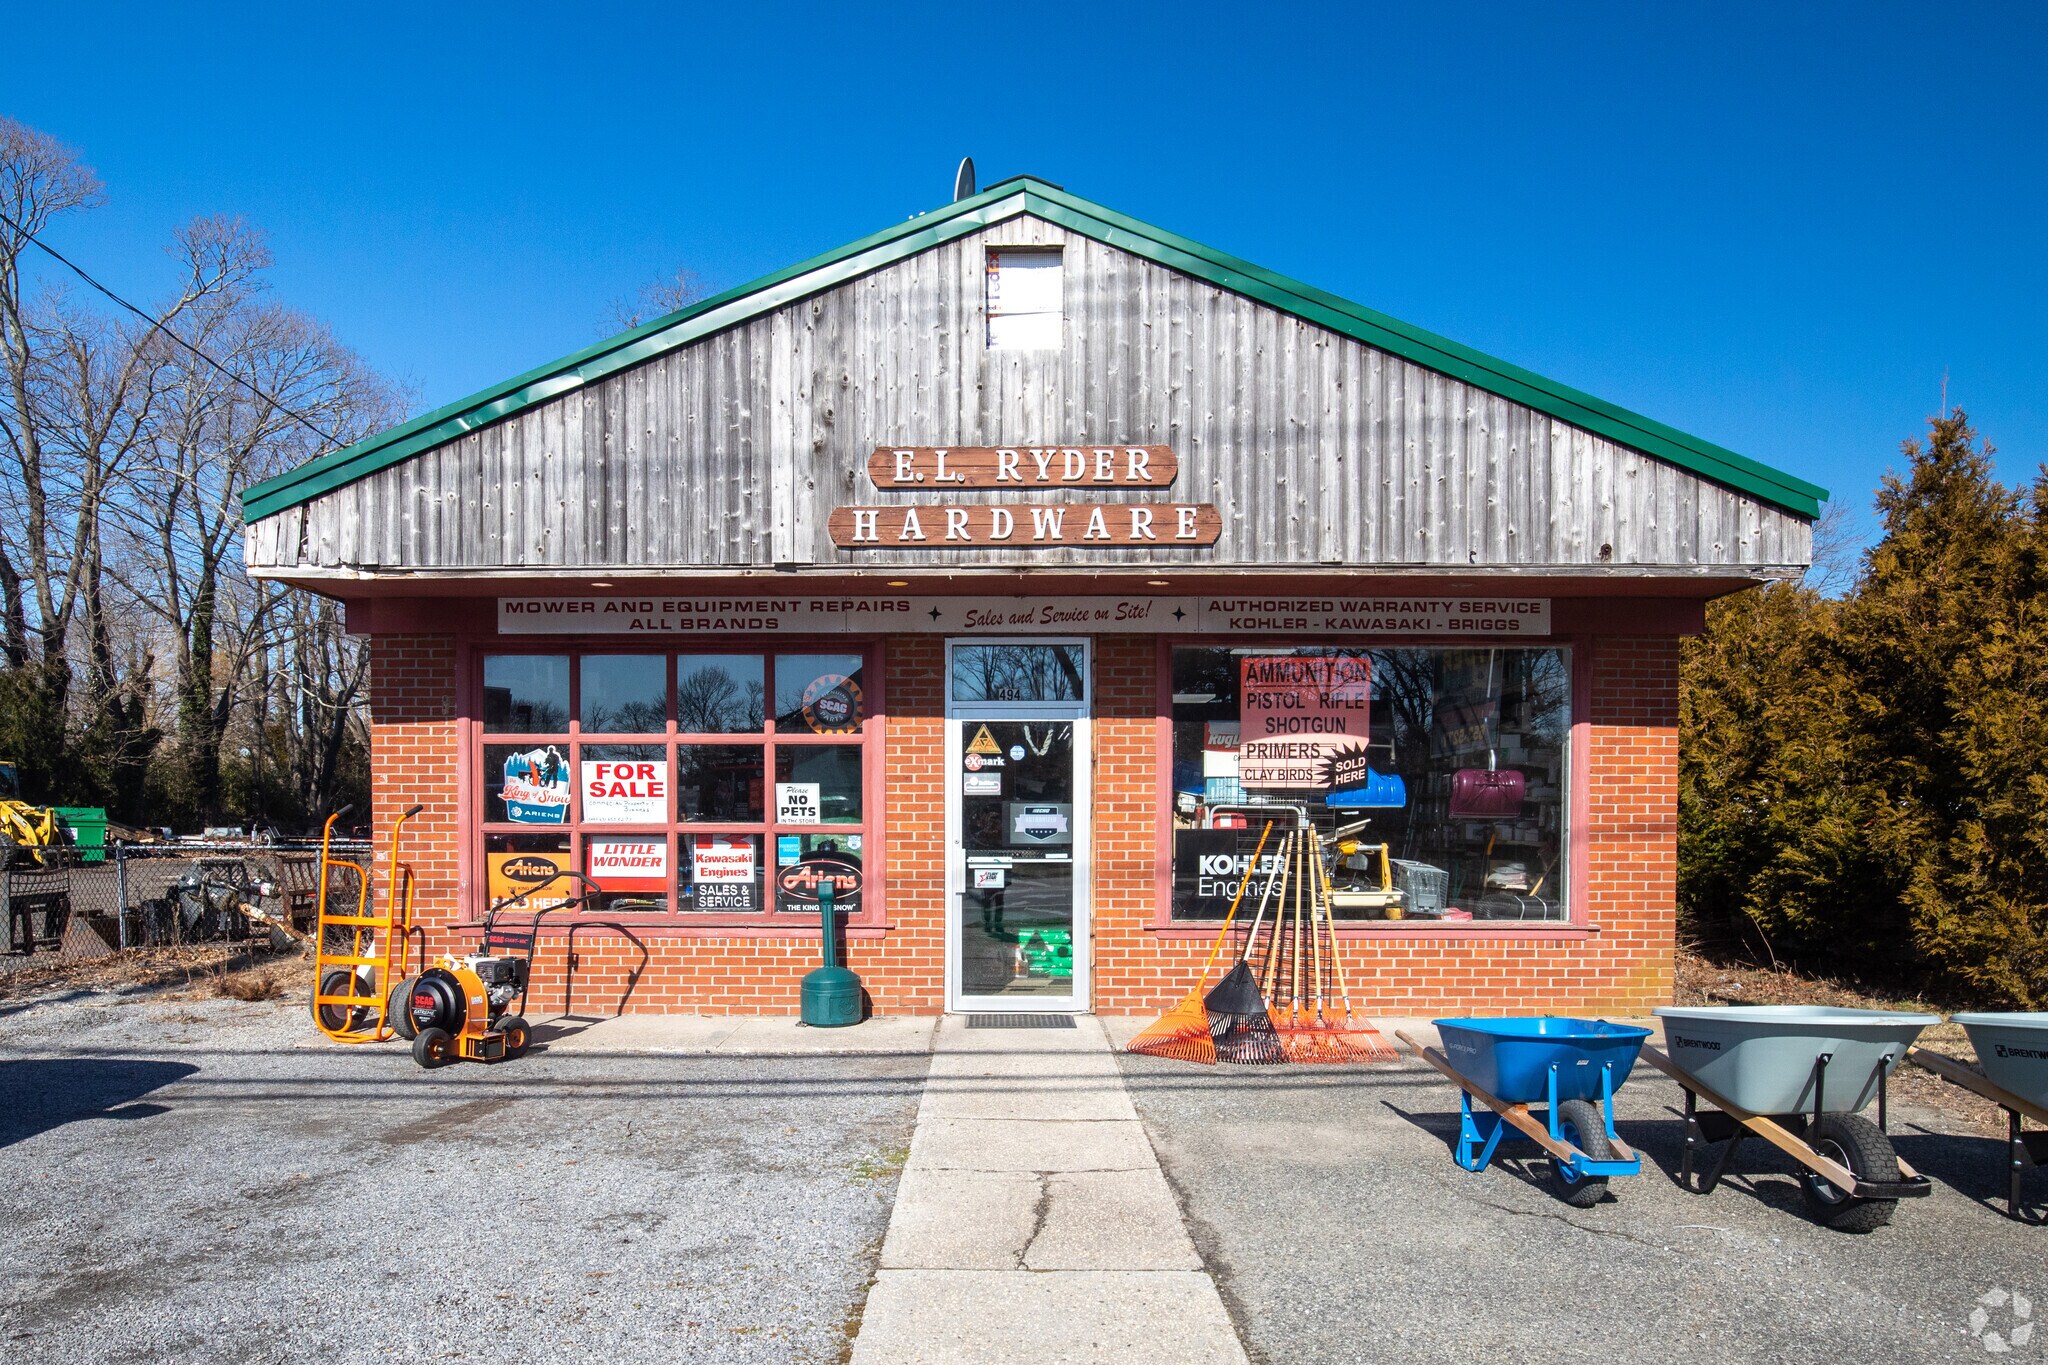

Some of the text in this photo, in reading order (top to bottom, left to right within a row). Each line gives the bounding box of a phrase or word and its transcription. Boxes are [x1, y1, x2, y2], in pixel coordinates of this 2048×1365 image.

[893, 448, 1152, 482] E.L. RYDER
[852, 506, 1198, 542] HARDWARE
[505, 600, 910, 614] MOWER AND EQUIPMENT REPAIRS
[964, 600, 1153, 628] Sales and Service on Site!
[1208, 600, 1541, 615] AUTHORIZED WARRANTY SERVICE
[629, 617, 779, 630] ALL BRANDS
[1229, 617, 1308, 630] KOHLER
[1325, 618, 1432, 631] KAWASAKI
[1449, 618, 1520, 631] BRIGGS
[1246, 661, 1367, 683] AMMUNITION
[999, 689, 1021, 700] 494
[1246, 692, 1364, 710] PISTOL RIFLE
[819, 699, 848, 714] SCAG
[820, 711, 844, 722] PARTS
[1265, 716, 1347, 734] SHOTGUN
[1246, 742, 1321, 759] PRIMERS
[964, 756, 1005, 768] eXmark
[1335, 756, 1366, 773] SOLD
[596, 763, 656, 780] FOR
[1244, 768, 1313, 781] CLAY BIRDS
[1335, 768, 1366, 785] HERE
[501, 785, 530, 801] King
[538, 789, 571, 803] Snow
[589, 781, 664, 798] SALE
[785, 786, 809, 794] Please
[788, 795, 808, 805] NO
[524, 810, 560, 819] ARIENS
[780, 806, 816, 817] PETS
[604, 844, 656, 854] LITTLE
[593, 856, 663, 867] WONDER
[695, 853, 752, 863] Kawasaki
[1199, 854, 1286, 875] KOHLER
[503, 859, 555, 876] Ariens
[701, 866, 748, 878] Engines
[699, 884, 750, 896] SALES &
[1198, 876, 1284, 901] Engines
[698, 896, 751, 907] SERVICE
[415, 995, 434, 1006] SCAG
[1683, 1039, 1721, 1051] BRENTWOOD
[2007, 1047, 2048, 1060] BRENTW
